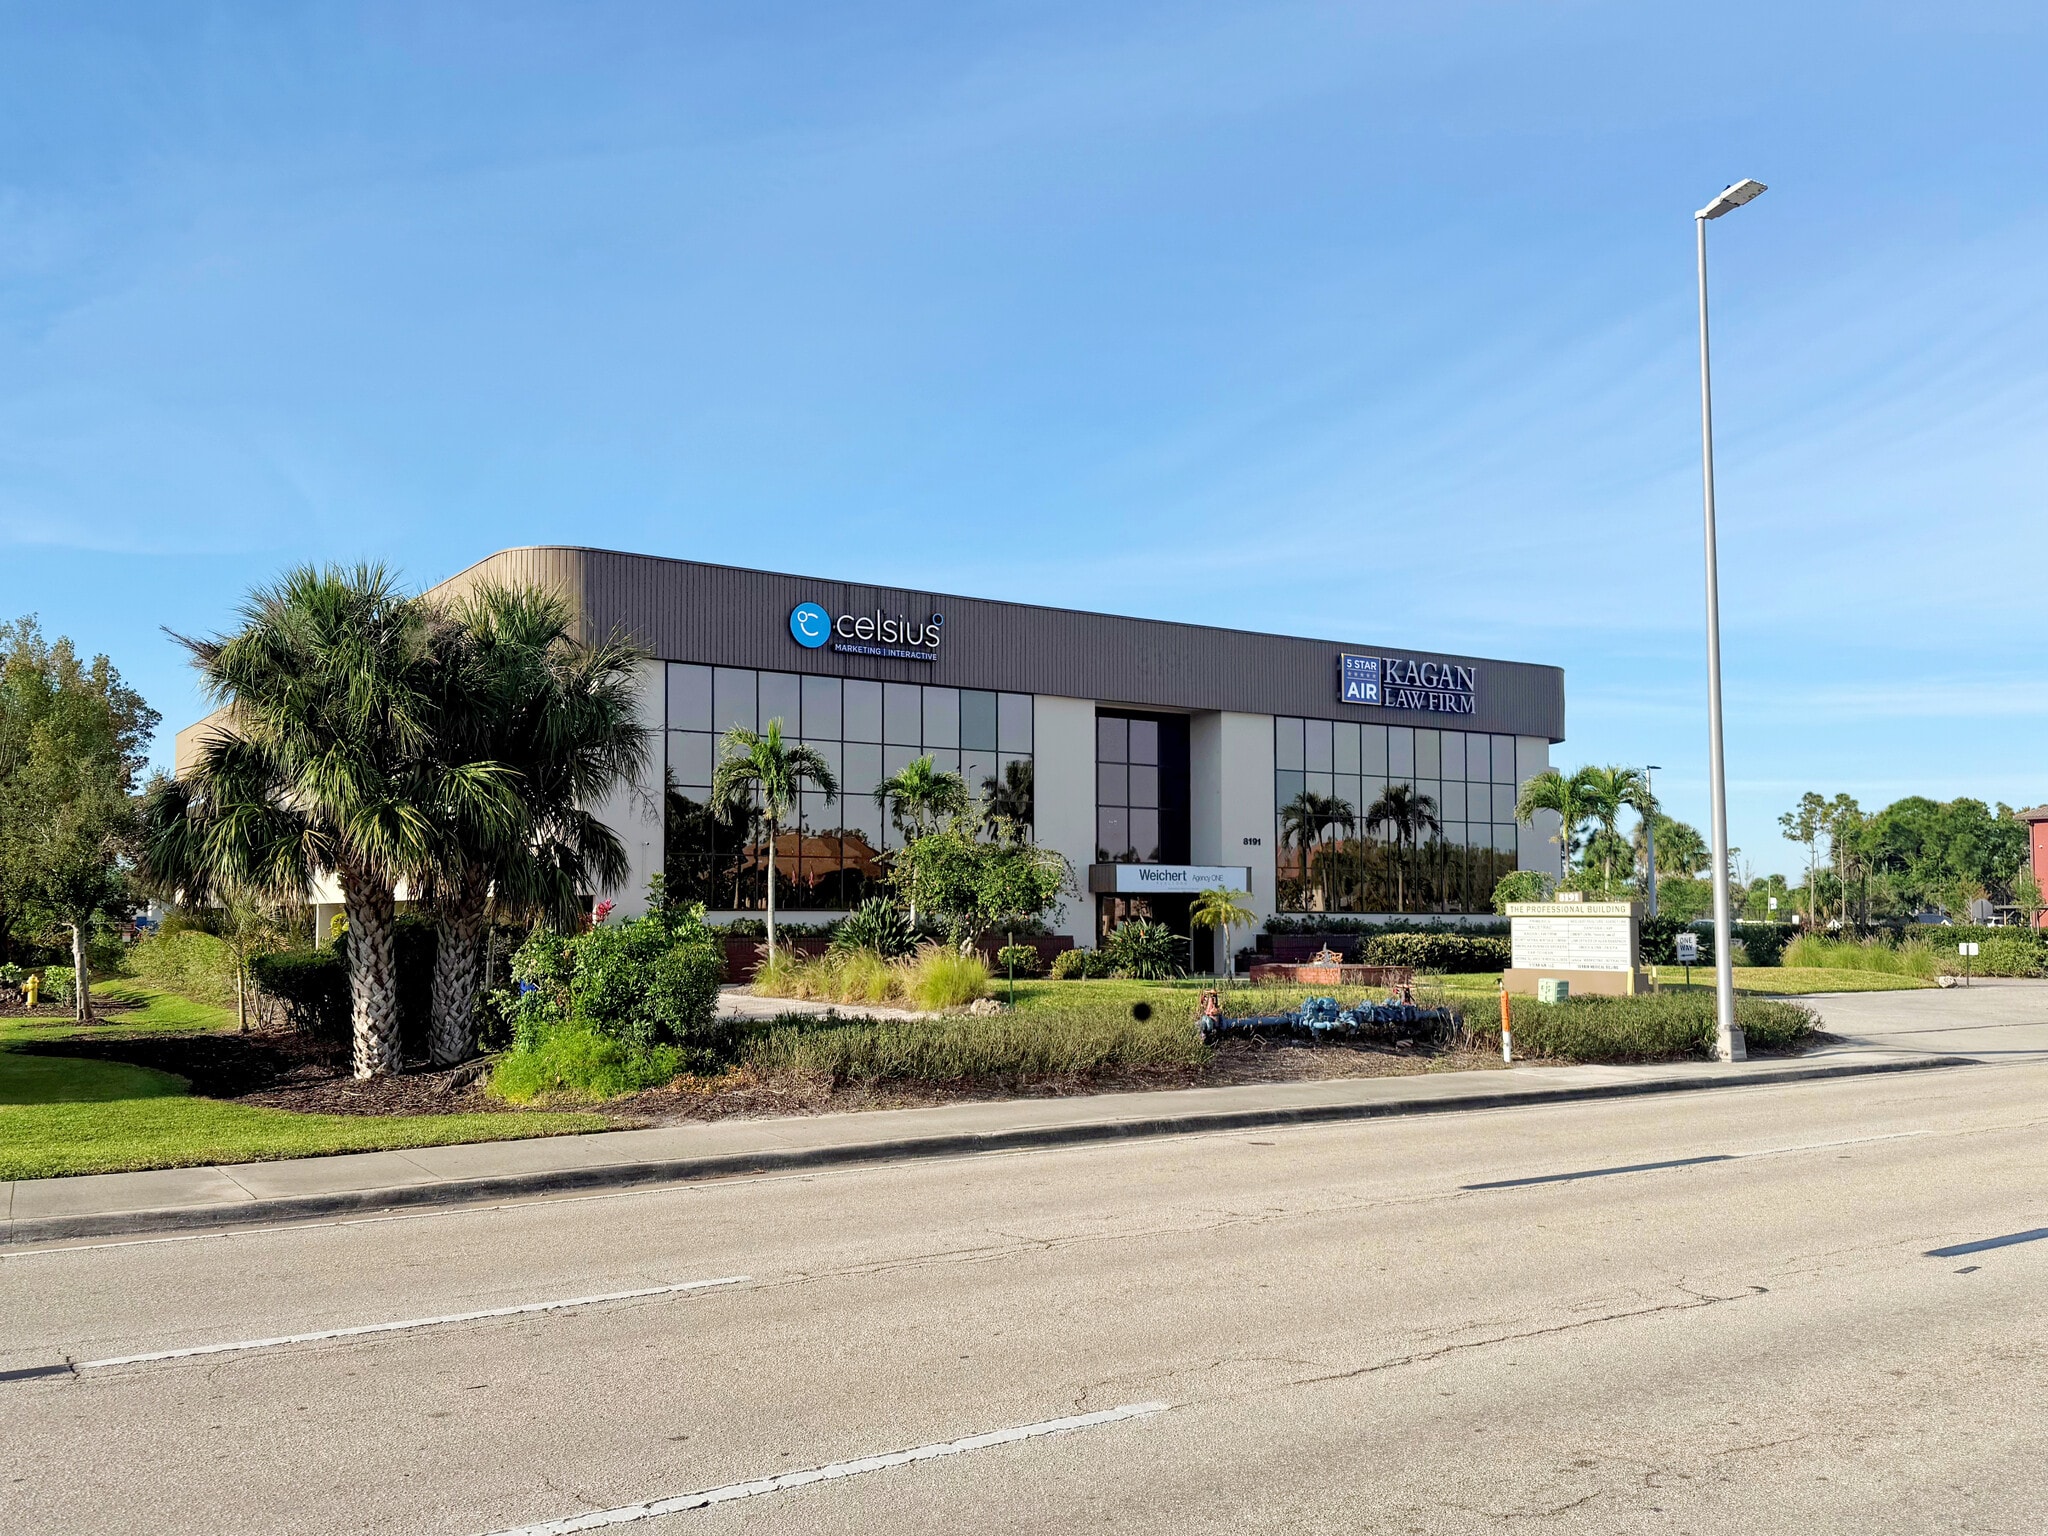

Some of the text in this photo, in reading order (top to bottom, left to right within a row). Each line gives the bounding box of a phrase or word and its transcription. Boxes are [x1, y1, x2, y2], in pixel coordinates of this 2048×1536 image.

[835, 643, 938, 661] MARKETING INTERACTIVE
[1346, 659, 1377, 670] 5 STAR
[1382, 657, 1476, 692] KAGAN
[1347, 682, 1377, 700] AIR
[1384, 688, 1476, 714] LAW FIRM
[1243, 837, 1261, 846] 8191
[1139, 869, 1224, 883] Weichert Agency ONE
[1558, 893, 1580, 902] 8191
[1510, 905, 1626, 914] THE PROFESSIONAL BUILDING
